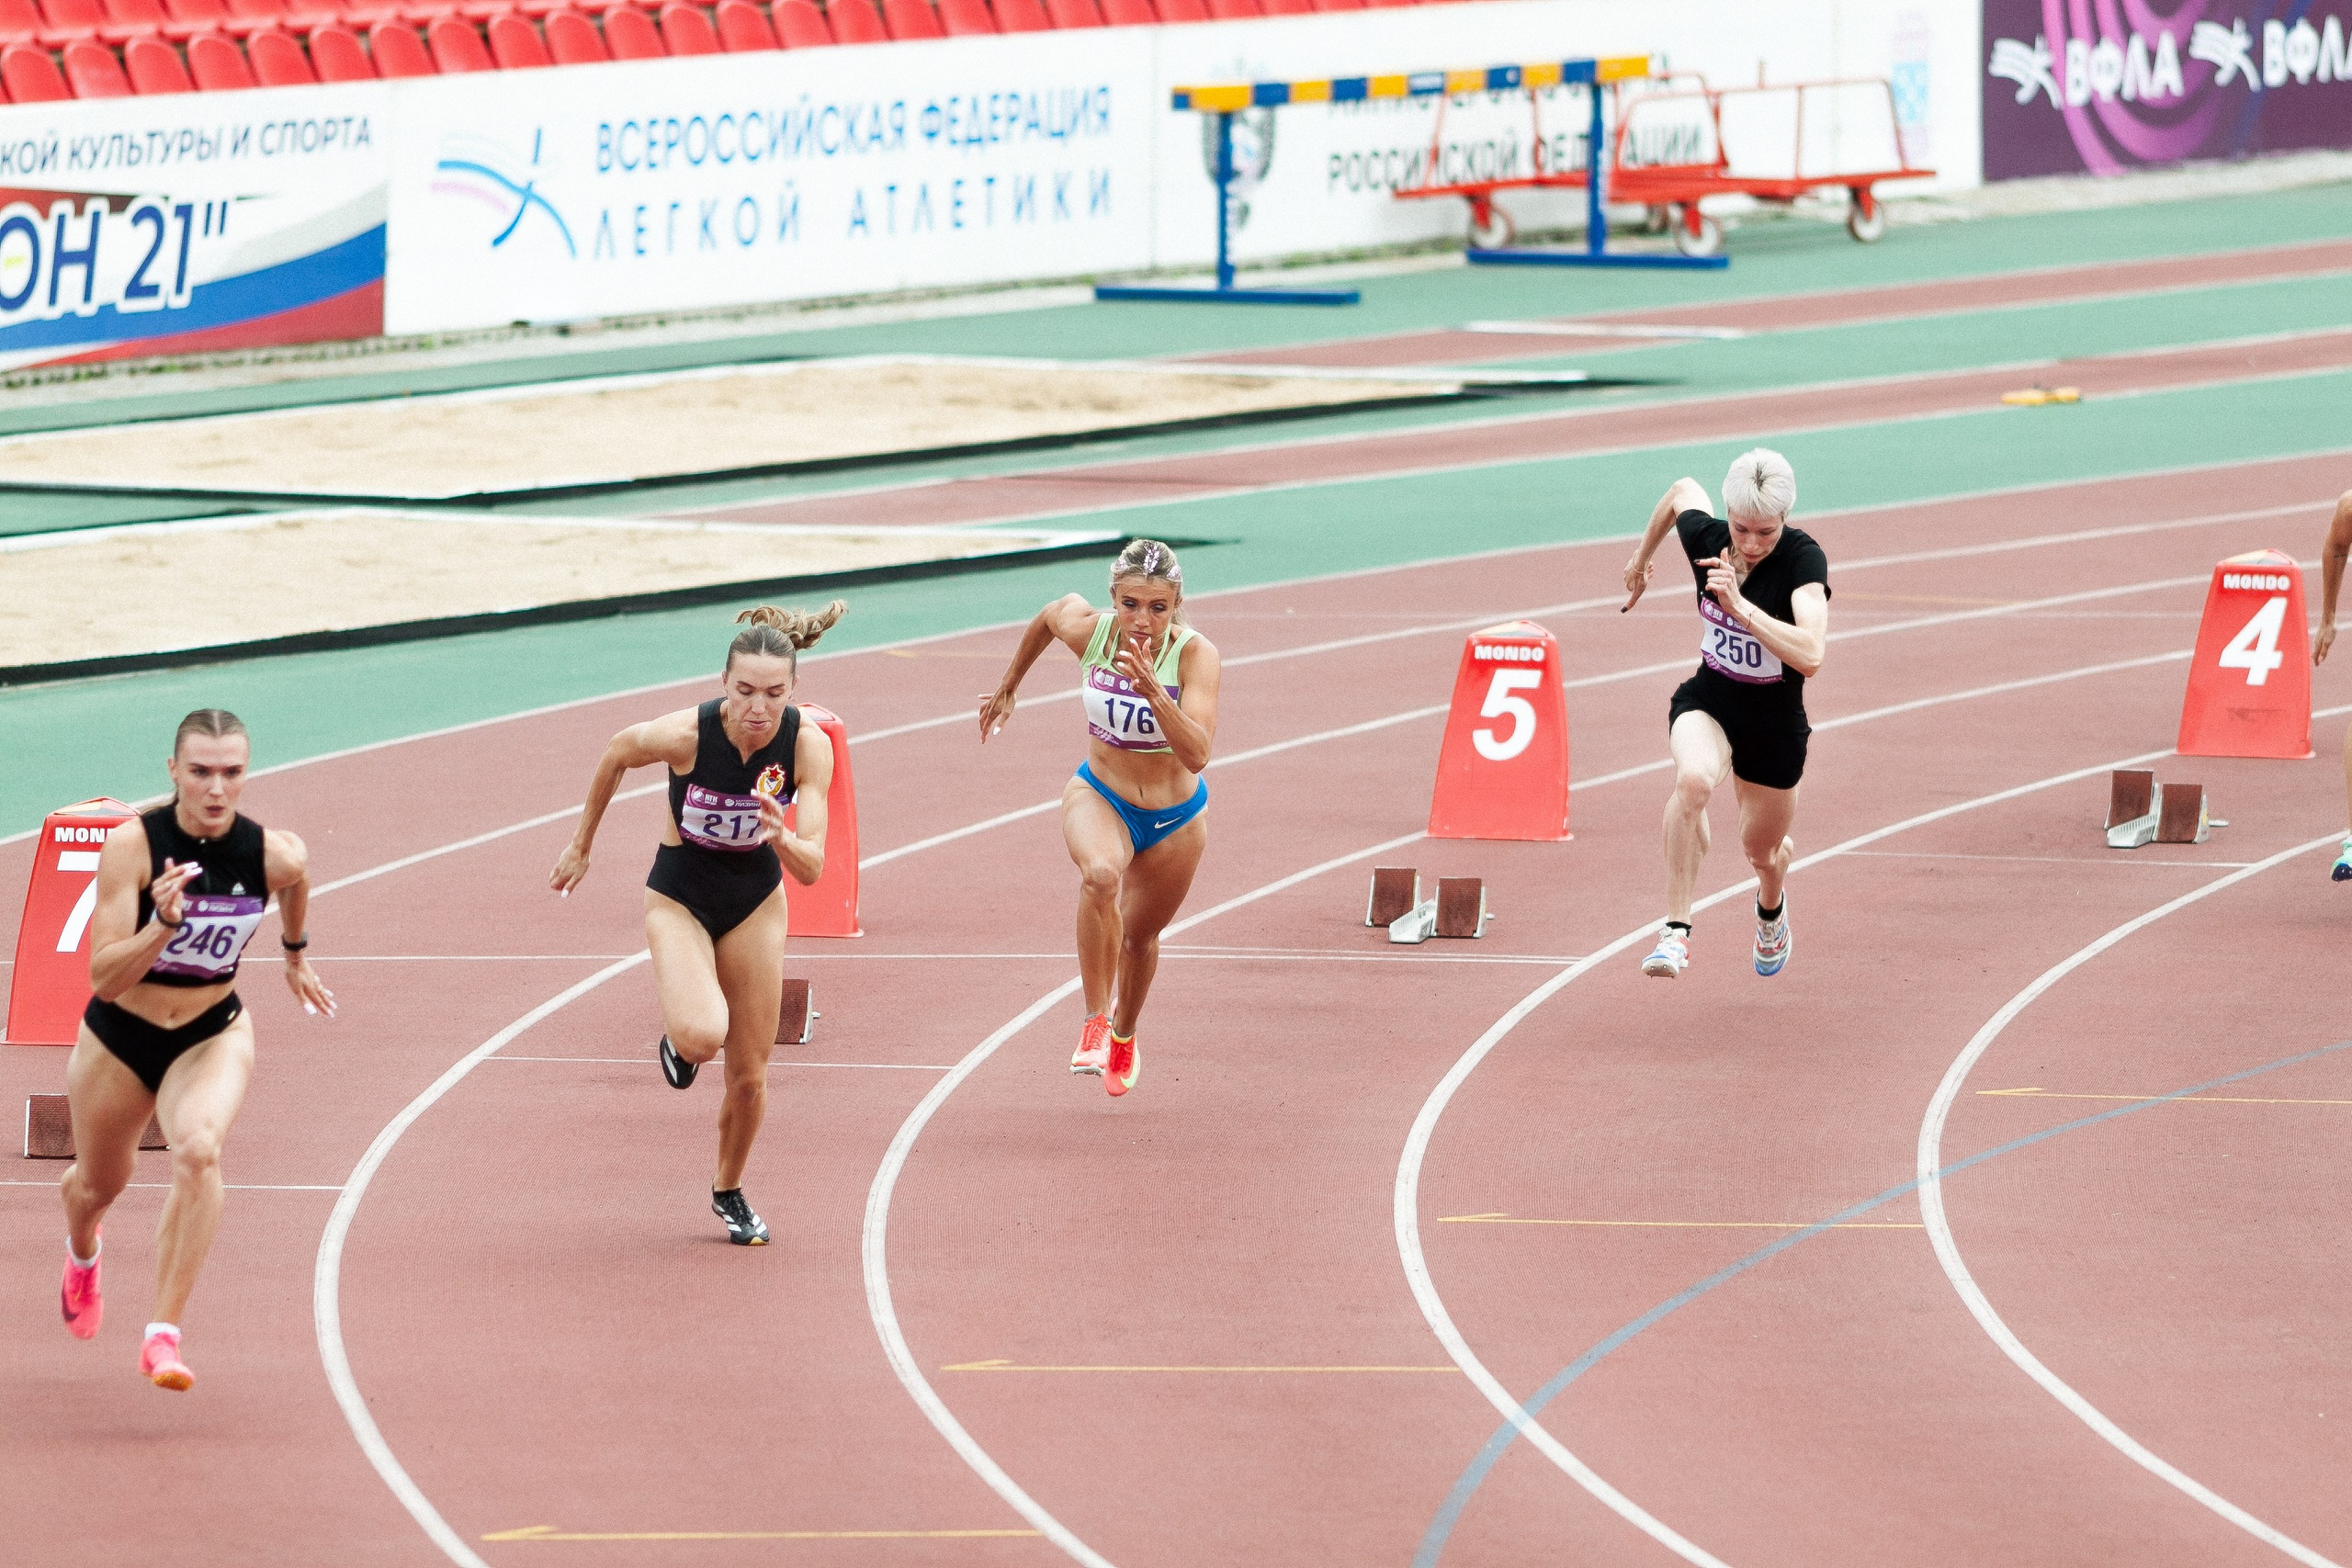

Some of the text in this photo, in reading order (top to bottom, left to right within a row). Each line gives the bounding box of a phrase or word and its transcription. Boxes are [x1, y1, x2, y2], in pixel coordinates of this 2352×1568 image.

[2064, 33, 2185, 107] ВФЛА
[0, 117, 370, 174] КОЙ КУЛЬТУРЫ И СПОРТА
[597, 85, 1109, 173] ВСЕРОССИЙСКАЯ ФЕДЕРАЦИЯ
[594, 166, 1110, 260] ЛЕГКОЙ АТЛЕТИКИ
[2223, 574, 2290, 591] MONDO
[1474, 645, 1545, 662] MONDO
[1714, 627, 1762, 669] 250
[2218, 596, 2288, 686] 4
[1104, 697, 1155, 735] 176
[1472, 668, 1544, 761] 5
[702, 813, 762, 840] 217
[56, 851, 101, 953] 7
[166, 921, 237, 959] 246
